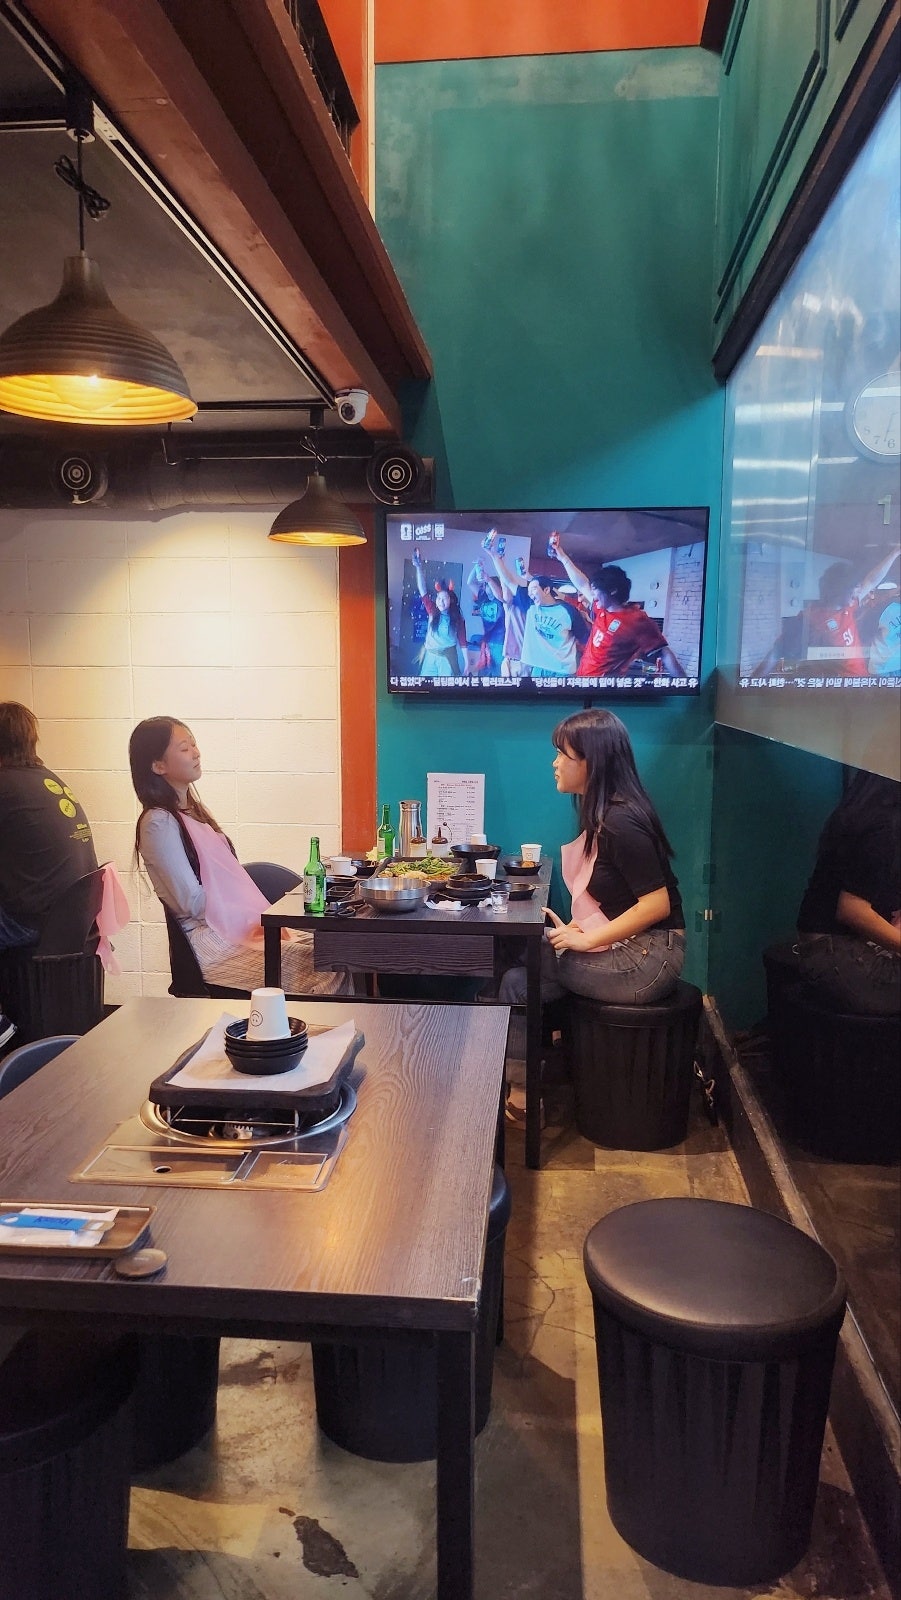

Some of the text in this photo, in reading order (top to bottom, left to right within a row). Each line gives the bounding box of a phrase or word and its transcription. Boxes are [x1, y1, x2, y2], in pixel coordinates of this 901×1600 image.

[887, 439, 896, 449] 6
[471, 677, 479, 687] 본
[671, 677, 687, 687] 사고
